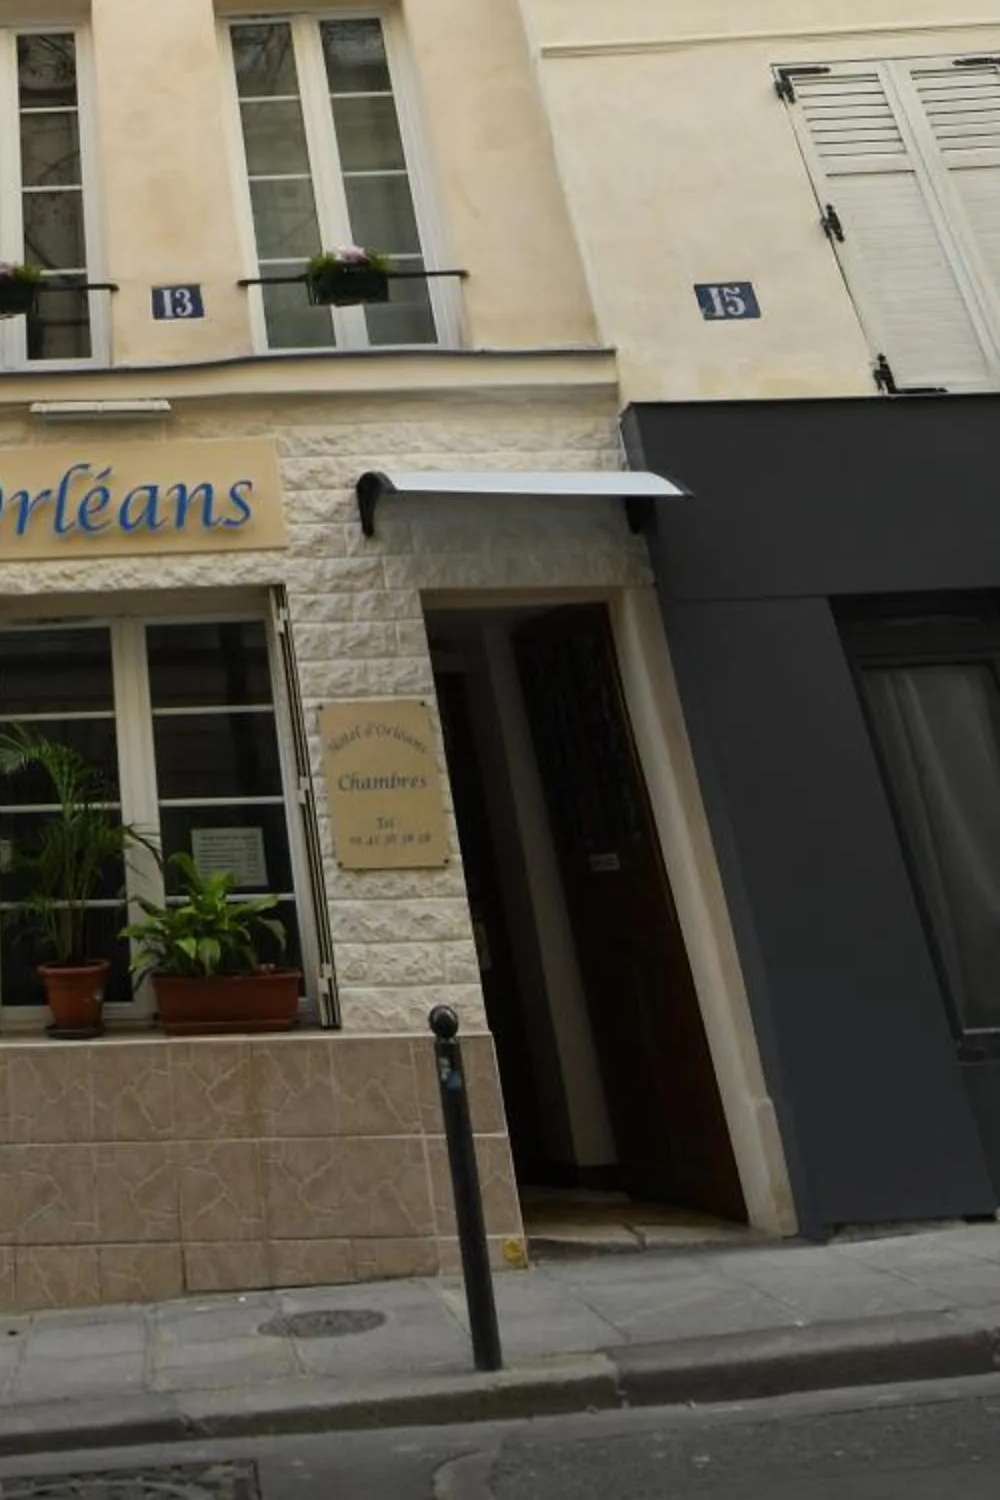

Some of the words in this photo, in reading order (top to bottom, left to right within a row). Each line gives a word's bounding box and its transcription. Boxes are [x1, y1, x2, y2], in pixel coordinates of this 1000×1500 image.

[161, 287, 194, 318] 13
[708, 286, 747, 317] 15
[338, 770, 427, 792] Chambres
